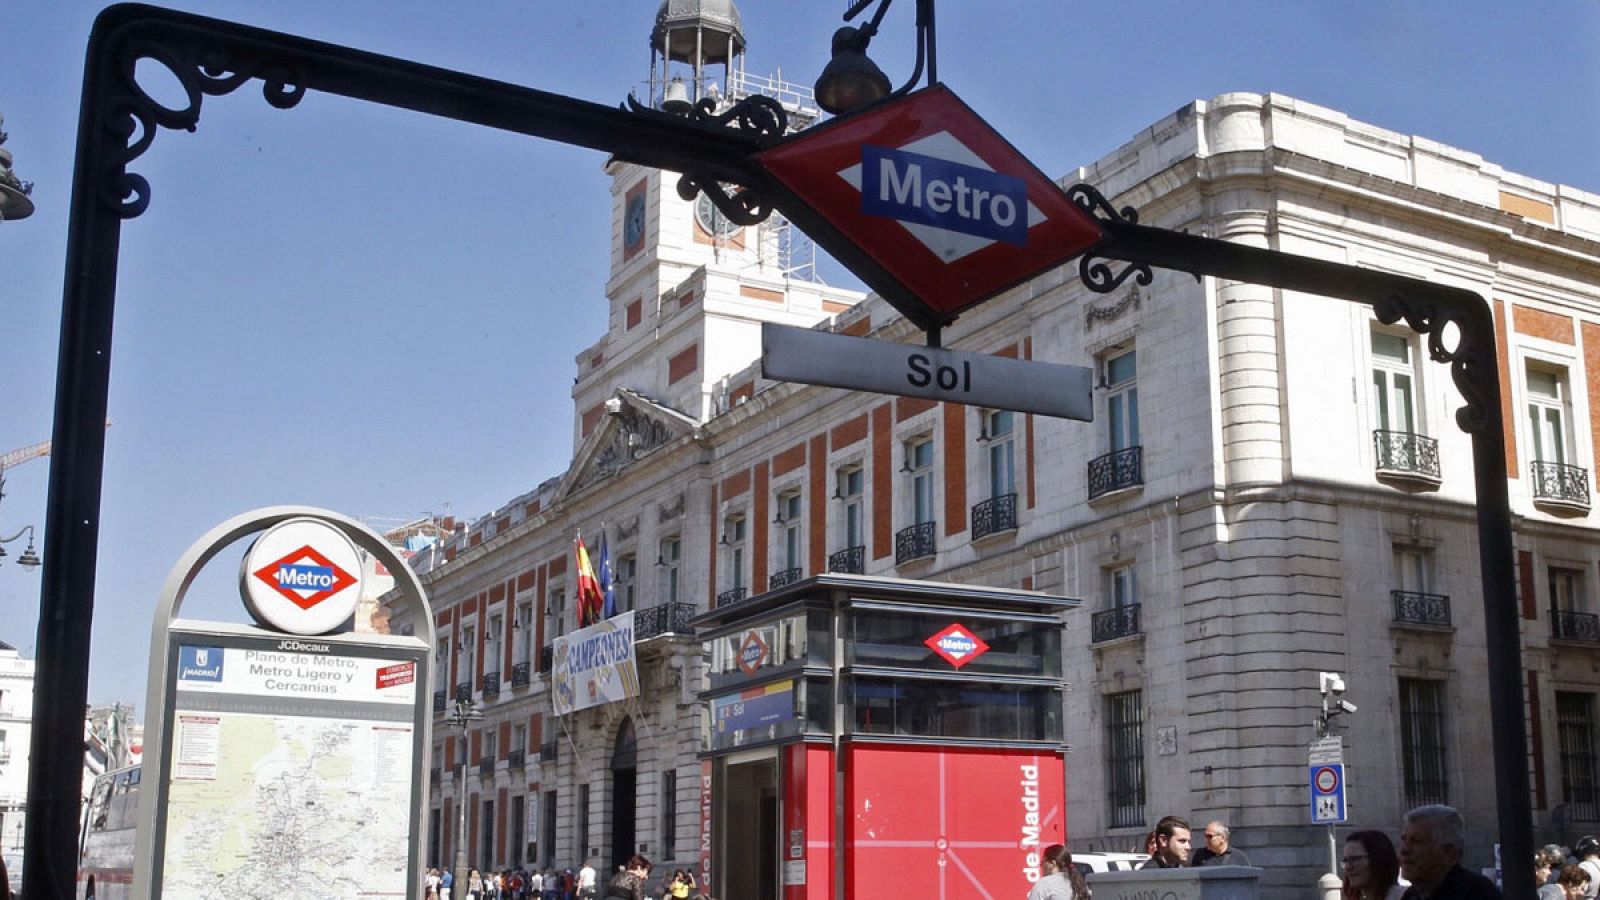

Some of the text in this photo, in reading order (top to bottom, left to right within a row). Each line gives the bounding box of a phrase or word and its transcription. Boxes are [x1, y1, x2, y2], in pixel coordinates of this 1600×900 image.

[880, 158, 1016, 227] Metro
[907, 354, 970, 392] Sol
[280, 567, 331, 587] Metro
[277, 641, 330, 653] JCDecaux
[943, 638, 973, 651] Metro
[245, 651, 287, 663] Plano
[291, 654, 309, 665] de
[250, 663, 354, 684] Metro Ligero y
[702, 775, 711, 852] Madrid
[1020, 764, 1041, 883] de Madrid
